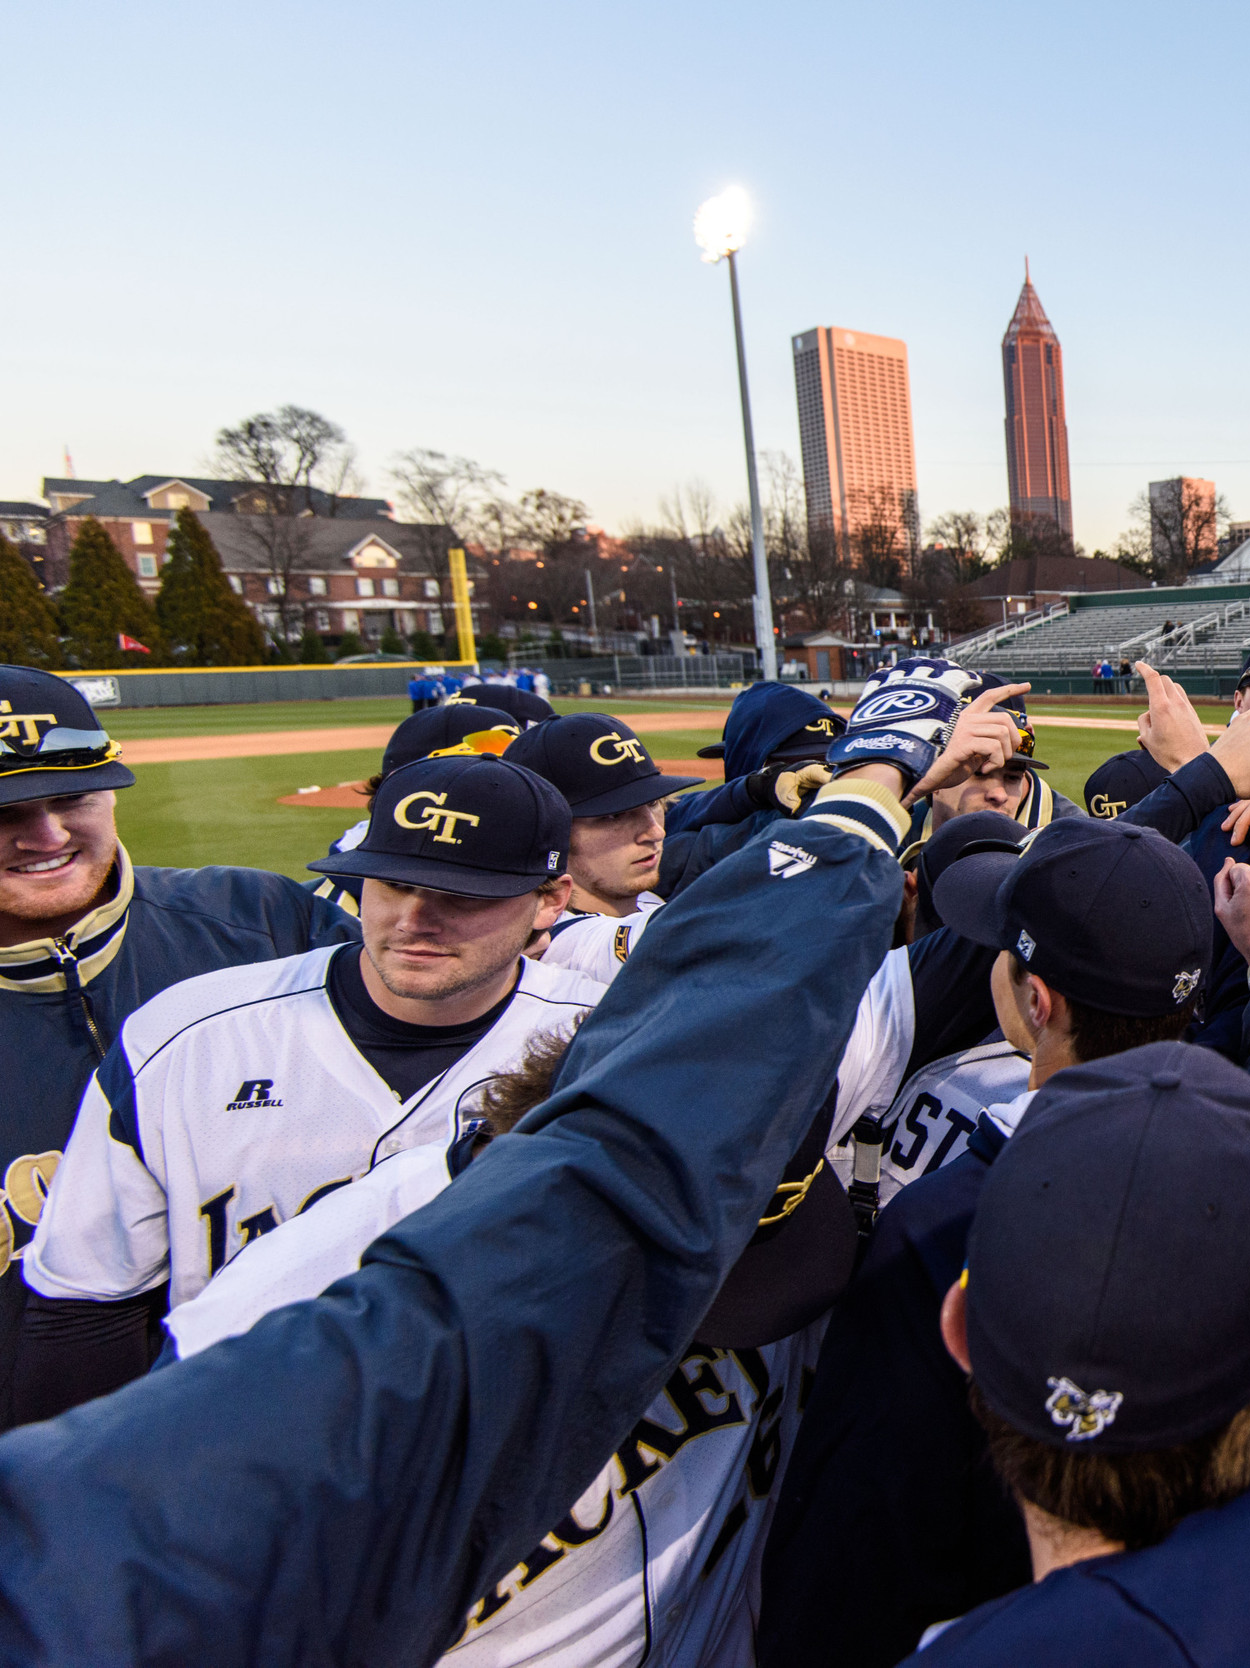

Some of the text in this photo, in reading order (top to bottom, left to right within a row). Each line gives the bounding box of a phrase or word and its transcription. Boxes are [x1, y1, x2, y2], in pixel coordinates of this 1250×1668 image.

[590, 731, 645, 765] GT
[844, 734, 917, 753] Rawlings
[1090, 793, 1127, 817] GT
[394, 791, 480, 844] GT
[616, 926, 628, 963] ACC
[233, 1079, 274, 1102] R
[225, 1099, 284, 1112] RUSSELL
